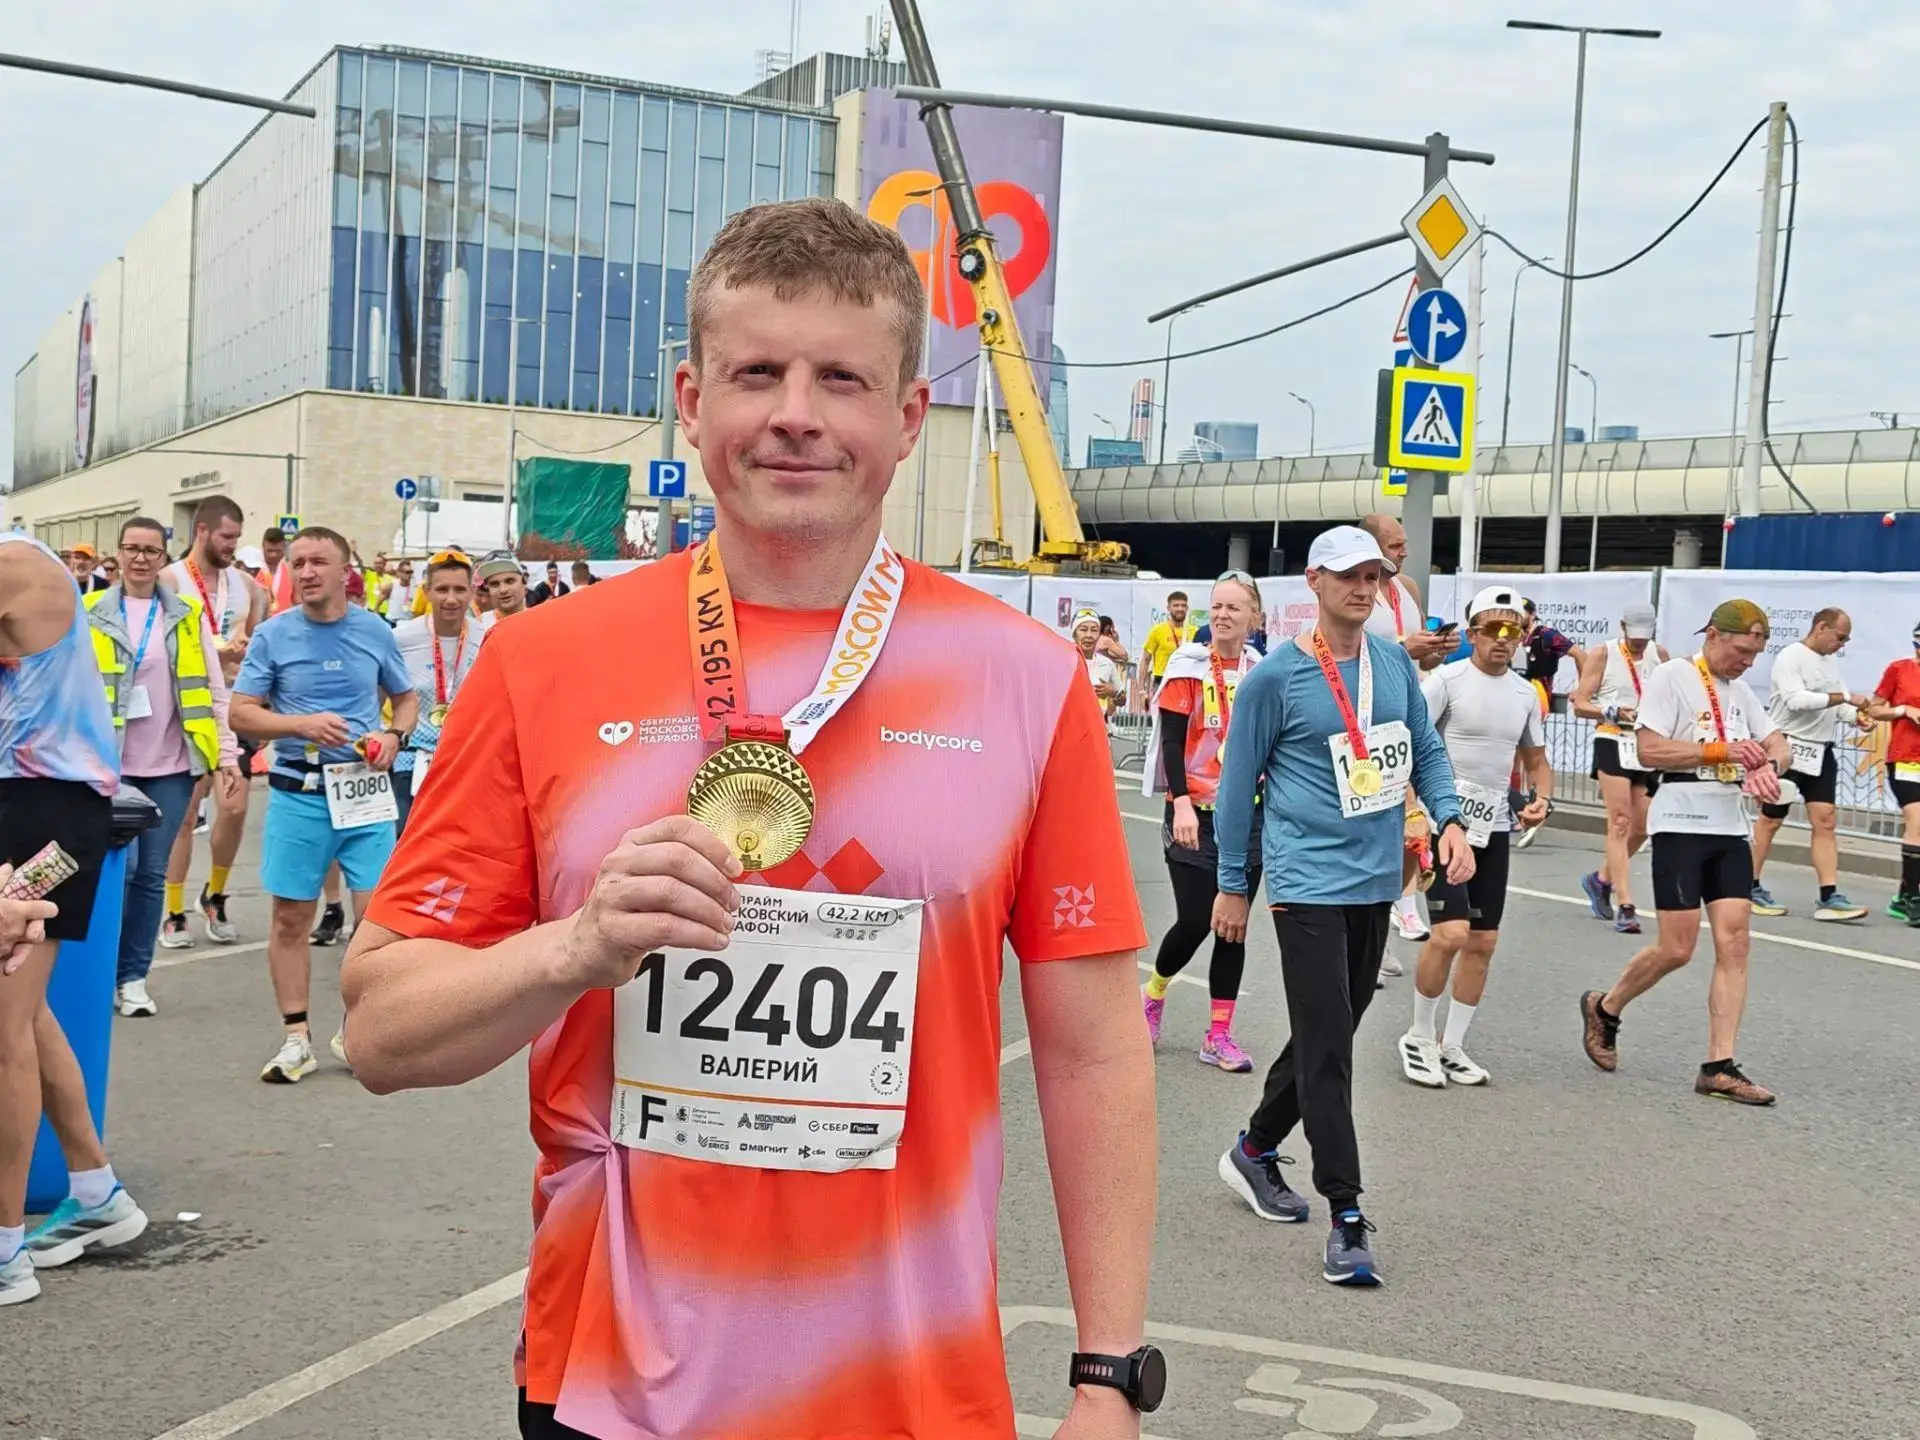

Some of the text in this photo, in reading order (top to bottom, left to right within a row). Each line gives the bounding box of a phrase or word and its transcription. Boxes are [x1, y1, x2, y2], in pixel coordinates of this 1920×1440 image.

[658, 464, 680, 494] P
[1537, 603, 1586, 615] ЕРПРАЙМ
[820, 576, 893, 695] MOSCOW
[1209, 714, 1219, 727] G
[639, 732, 698, 745] МАРАФОН
[880, 726, 983, 753] bodycore
[1338, 740, 1409, 779] 1589
[331, 774, 389, 801] 13080
[1350, 797, 1362, 811] D
[741, 895, 782, 907] ПРАЙМ
[826, 907, 859, 921] 42,2
[734, 920, 780, 935] АФОН
[634, 952, 906, 1053] 12404
[699, 1053, 819, 1083] ВАЛЕРИЙ
[880, 1071, 892, 1085] 2
[639, 1094, 667, 1140] F
[822, 1123, 849, 1132] СБЕР
